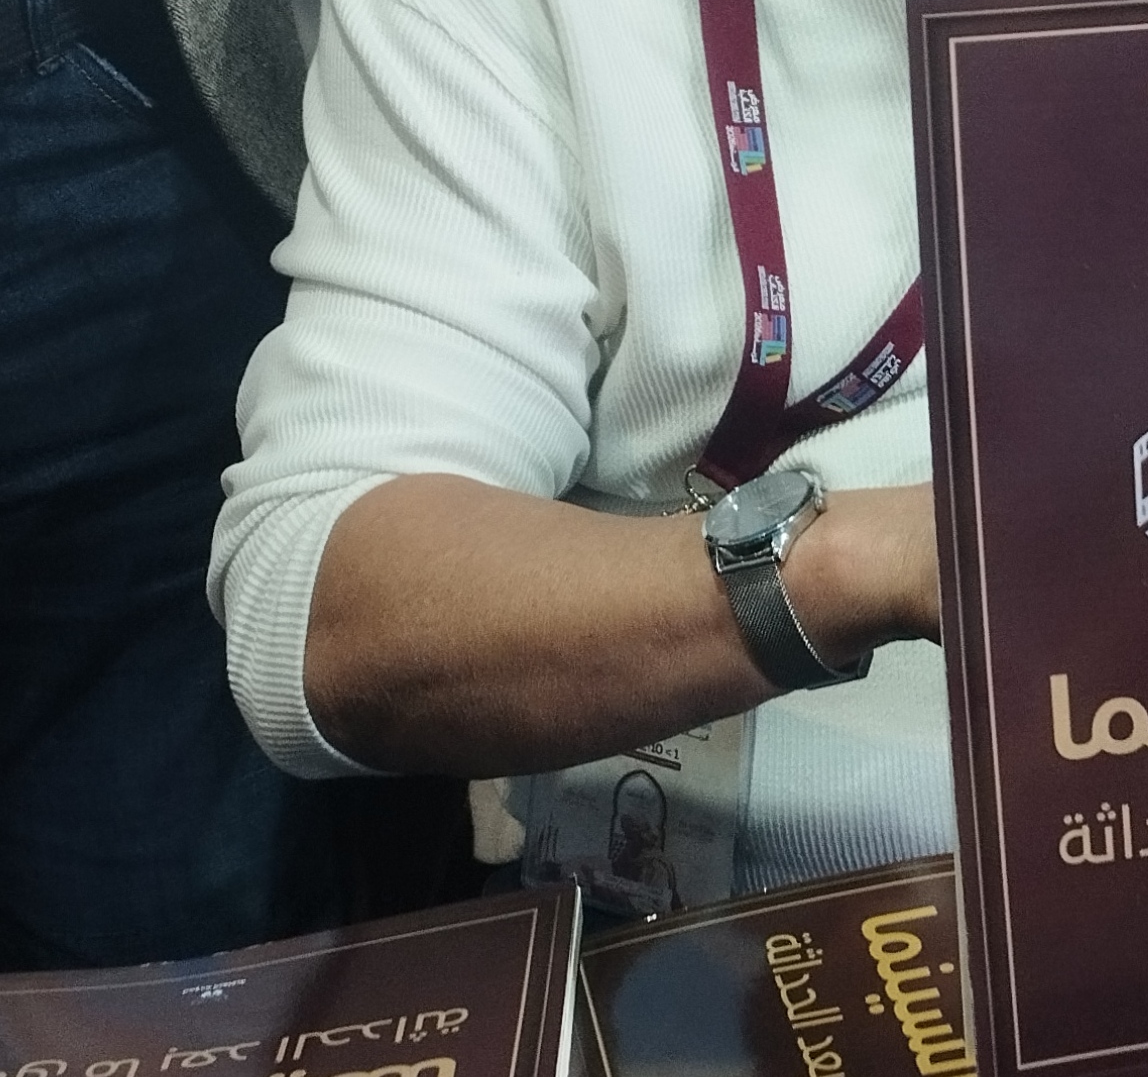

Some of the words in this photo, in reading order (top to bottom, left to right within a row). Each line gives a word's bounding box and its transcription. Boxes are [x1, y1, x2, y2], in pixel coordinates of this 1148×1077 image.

[765, 932, 844, 1030] الحداثة
[861, 905, 977, 1077] لسينما
[160, 1040, 261, 1072] بعد
[274, 1007, 469, 1064] الحداثة
